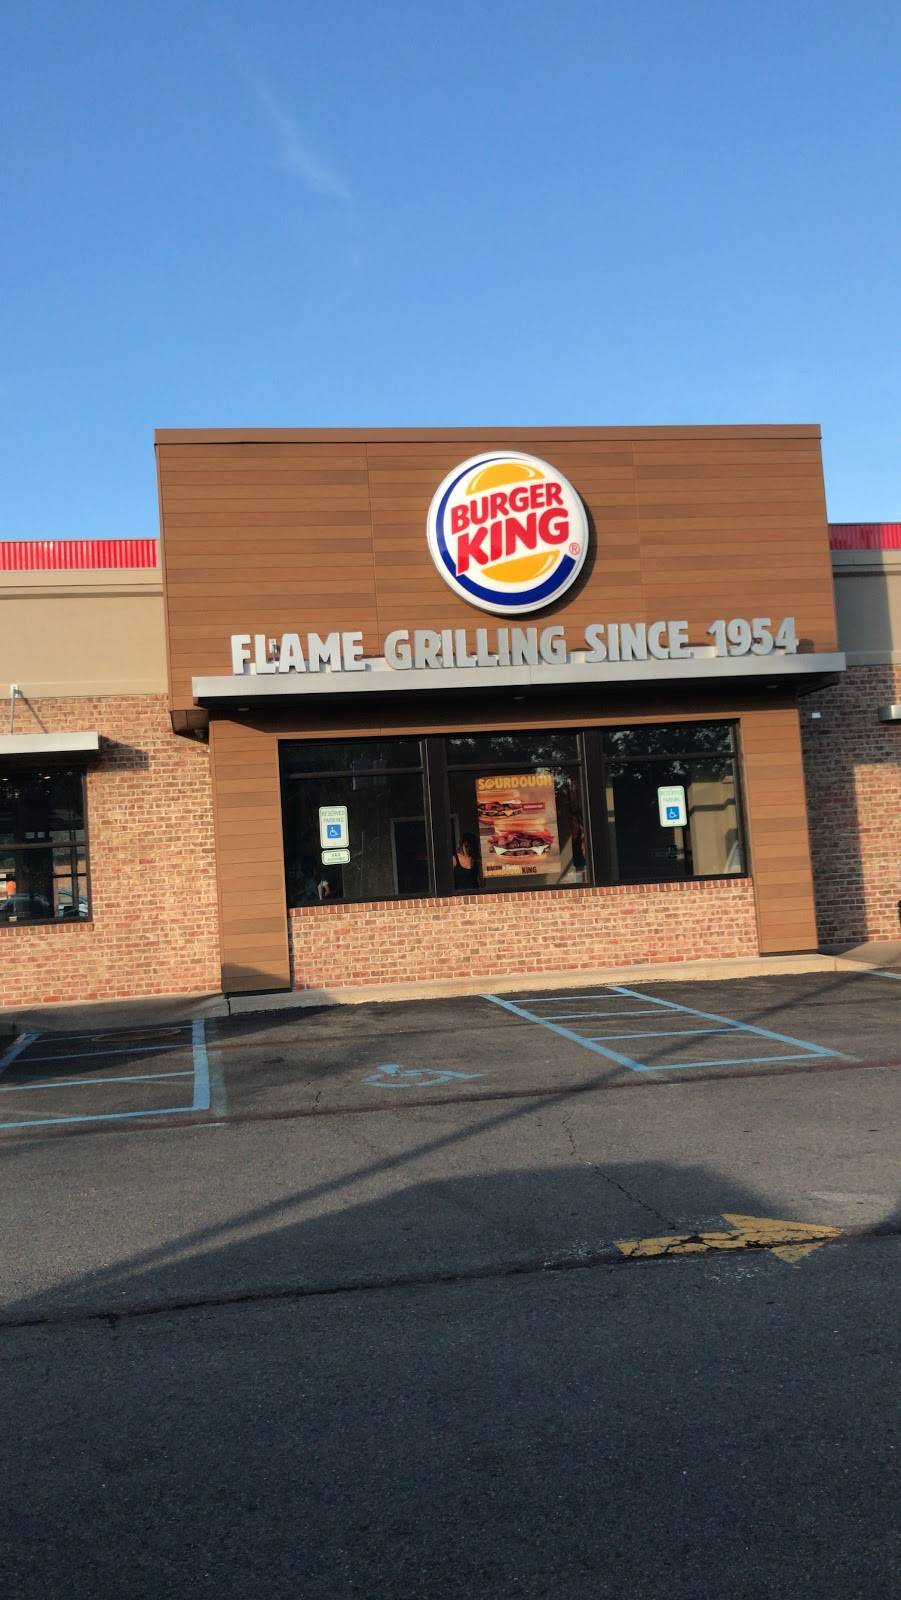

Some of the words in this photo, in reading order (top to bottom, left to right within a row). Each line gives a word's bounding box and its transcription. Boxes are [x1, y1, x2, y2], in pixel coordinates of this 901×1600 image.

[451, 482, 564, 535] BURGER
[457, 507, 569, 575] KING
[230, 631, 366, 676] FLAME
[383, 625, 567, 670] GRILLING
[584, 620, 689, 663] SINCE
[706, 616, 799, 658] 1954
[478, 774, 552, 791] SOURDOUGH
[521, 866, 538, 874] KING
